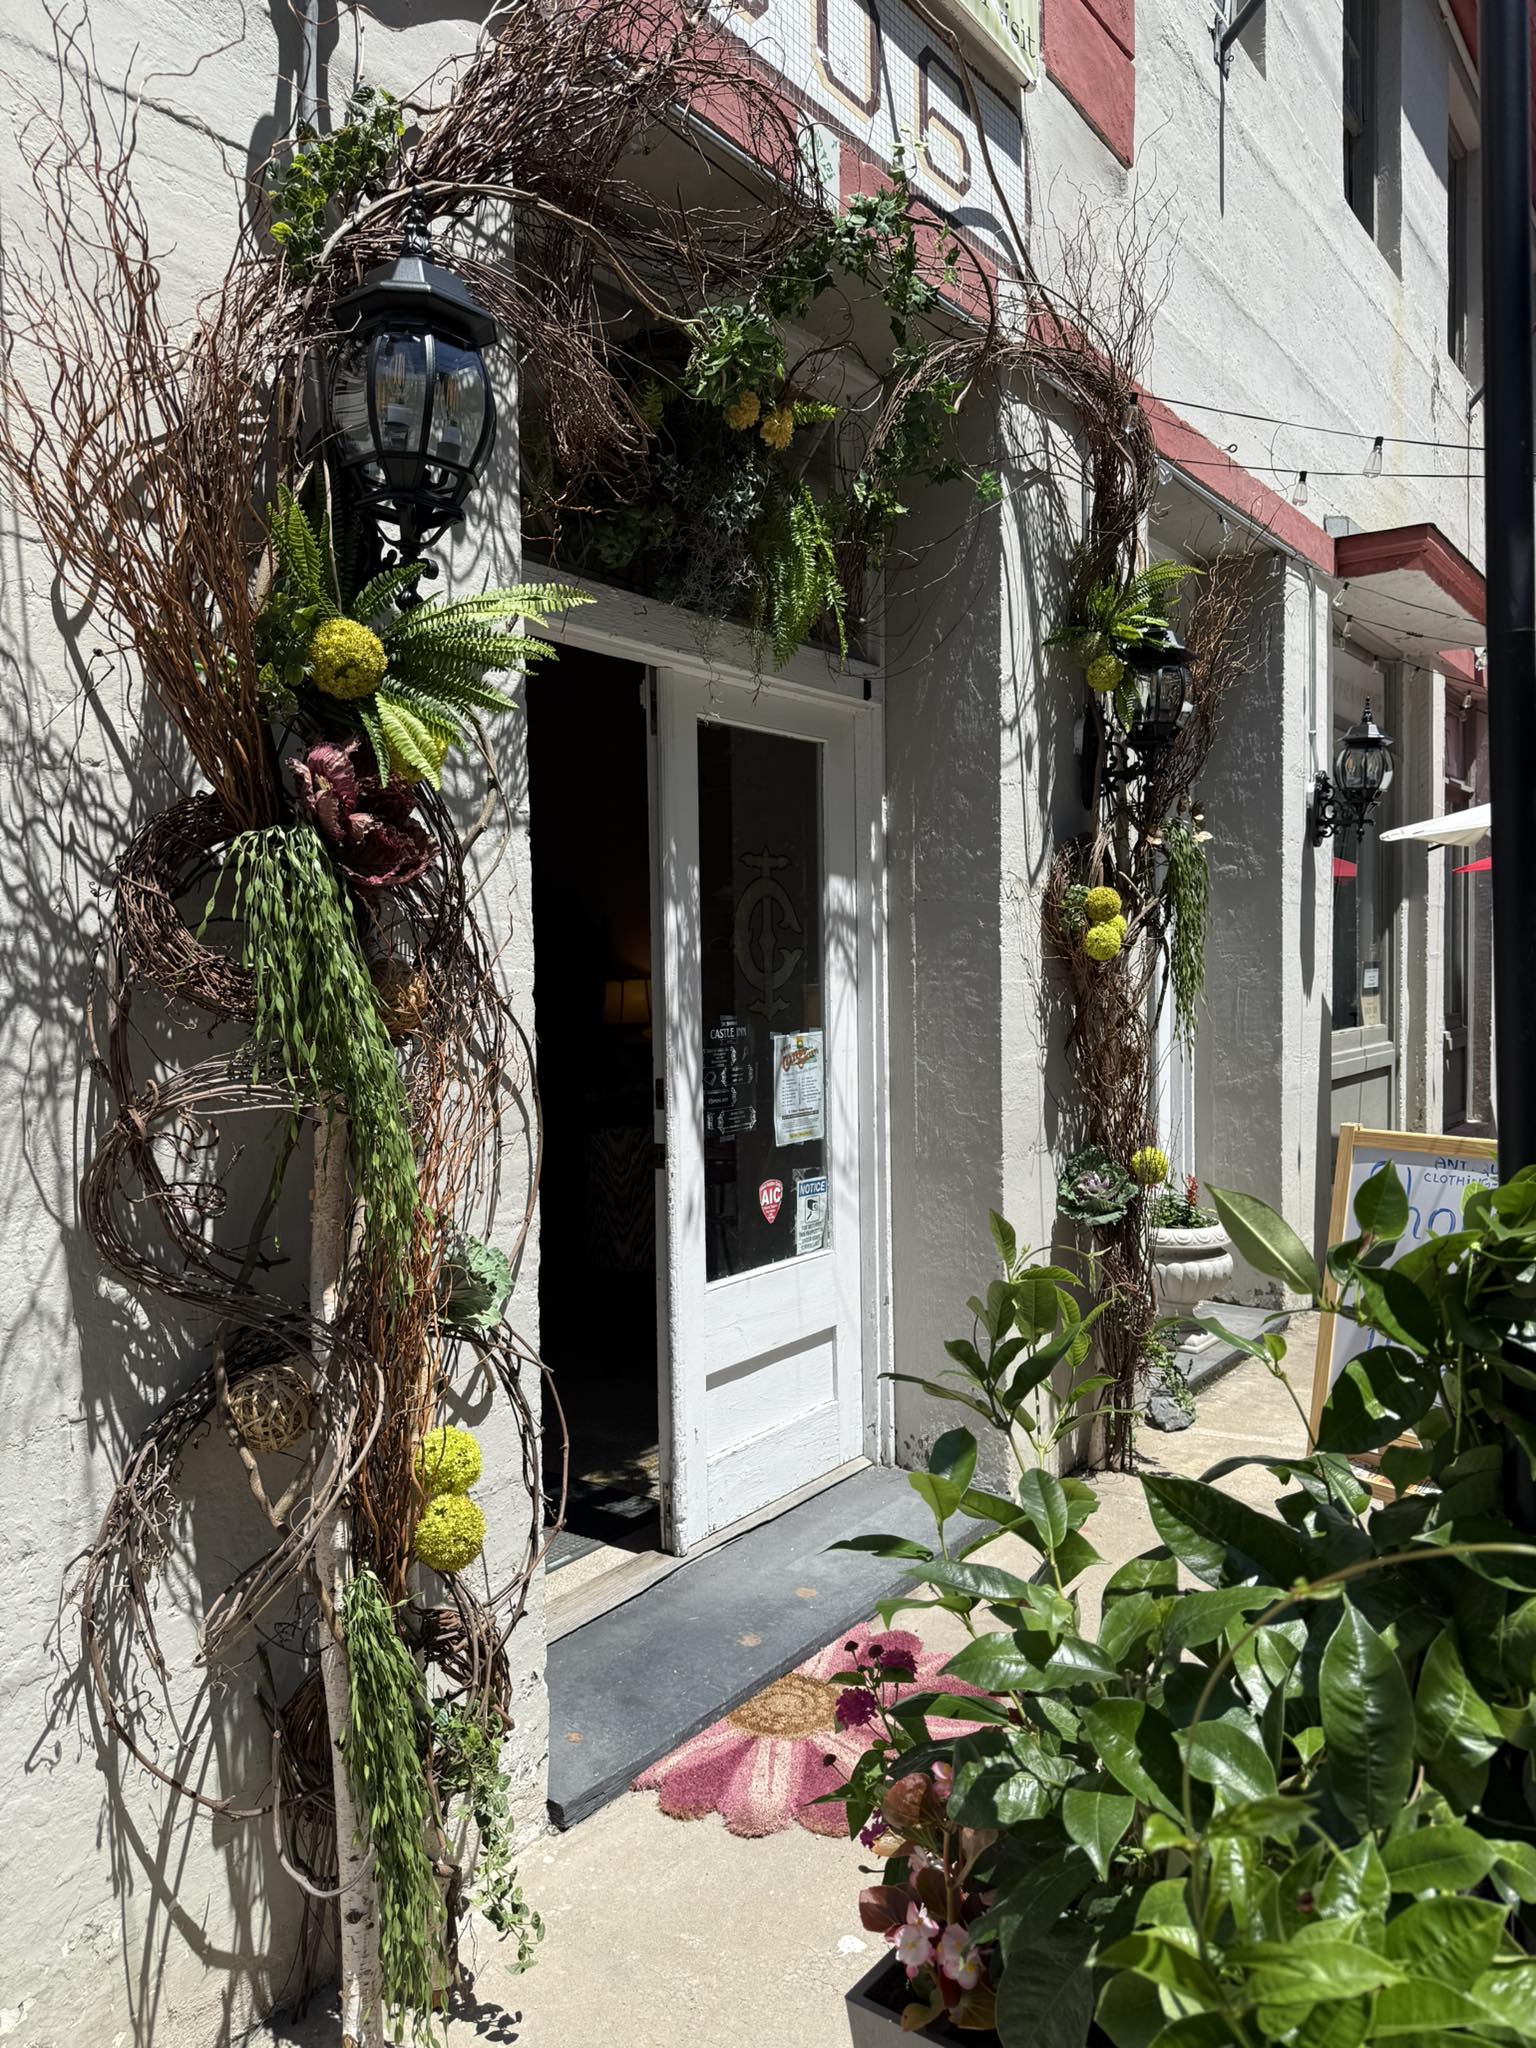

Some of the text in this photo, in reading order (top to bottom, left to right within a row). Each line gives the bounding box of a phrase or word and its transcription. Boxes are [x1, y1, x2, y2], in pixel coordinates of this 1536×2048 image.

[710, 1027, 735, 1040] CASTLE
[761, 1186, 781, 1206] AIC
[799, 1180, 826, 1196] NOTICE
